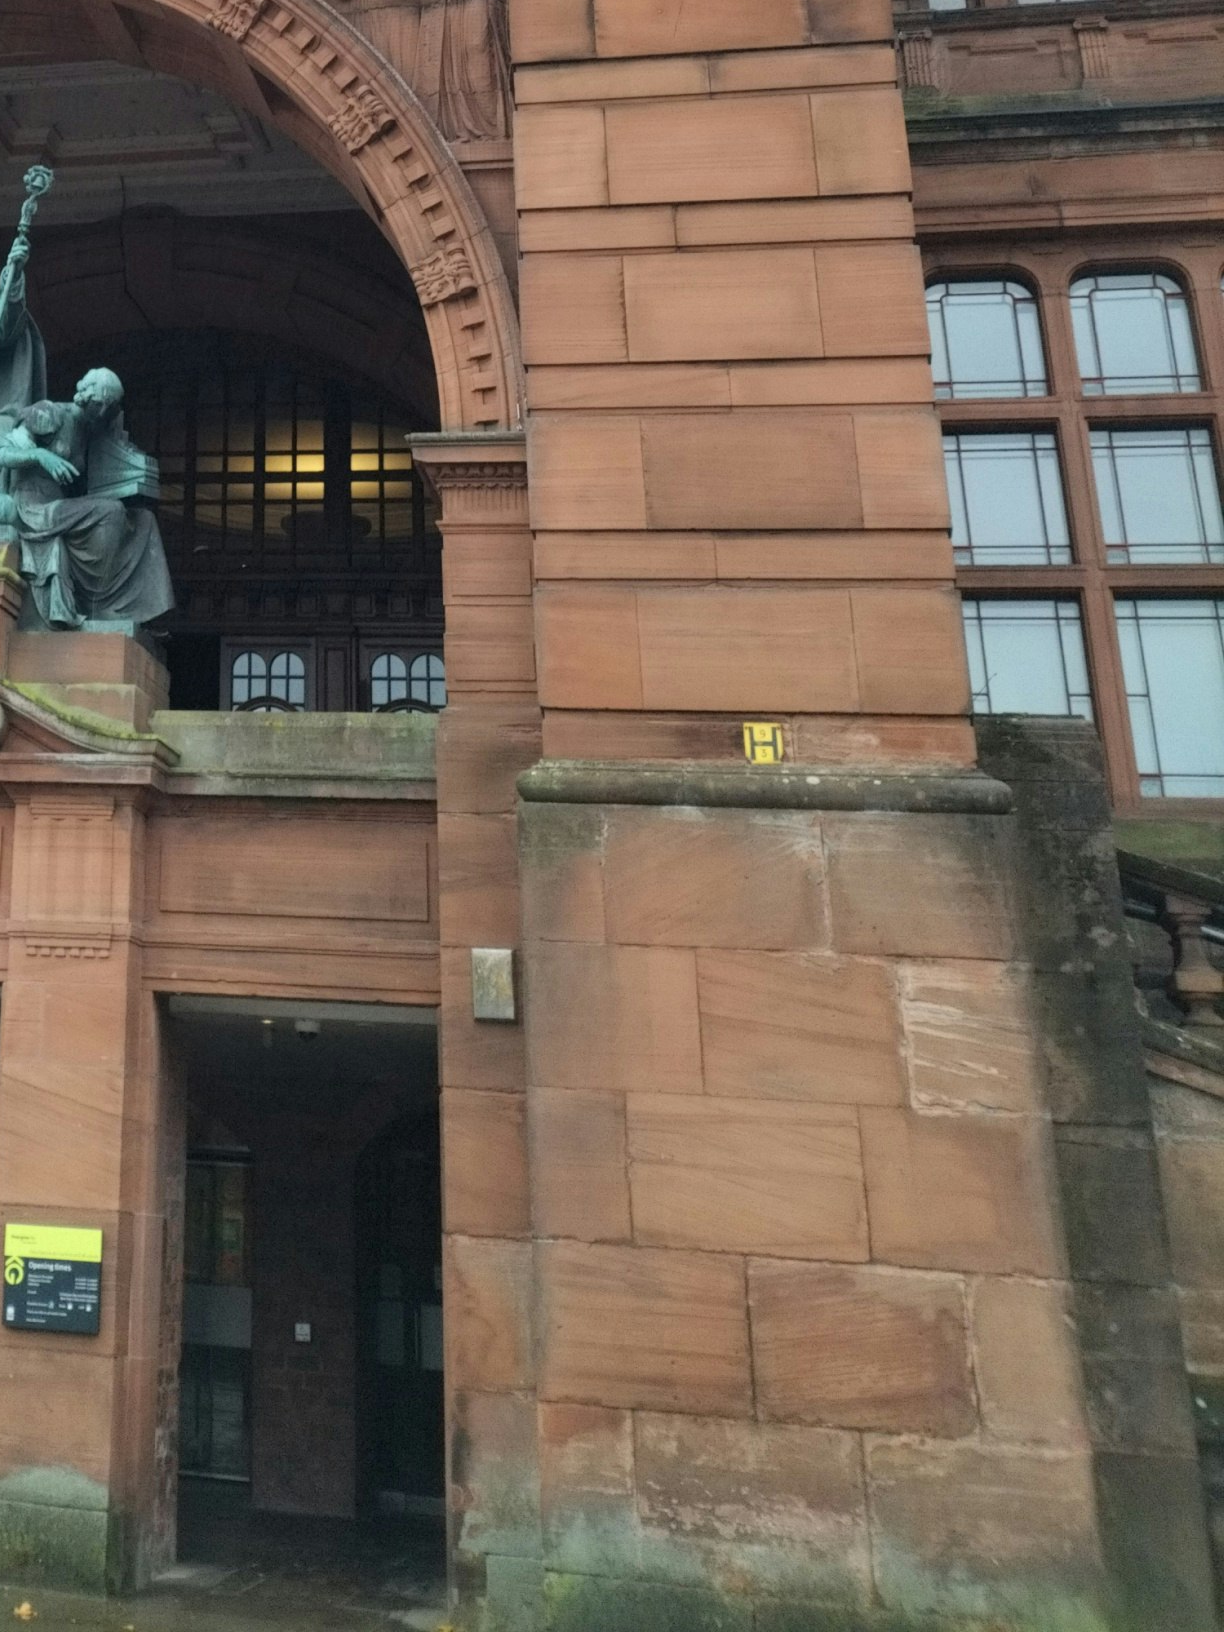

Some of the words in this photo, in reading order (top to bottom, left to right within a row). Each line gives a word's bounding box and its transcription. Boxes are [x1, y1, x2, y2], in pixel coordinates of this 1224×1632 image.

[748, 726, 779, 761] H
[28, 1261, 54, 1272] Opening
[55, 1263, 72, 1272] times
